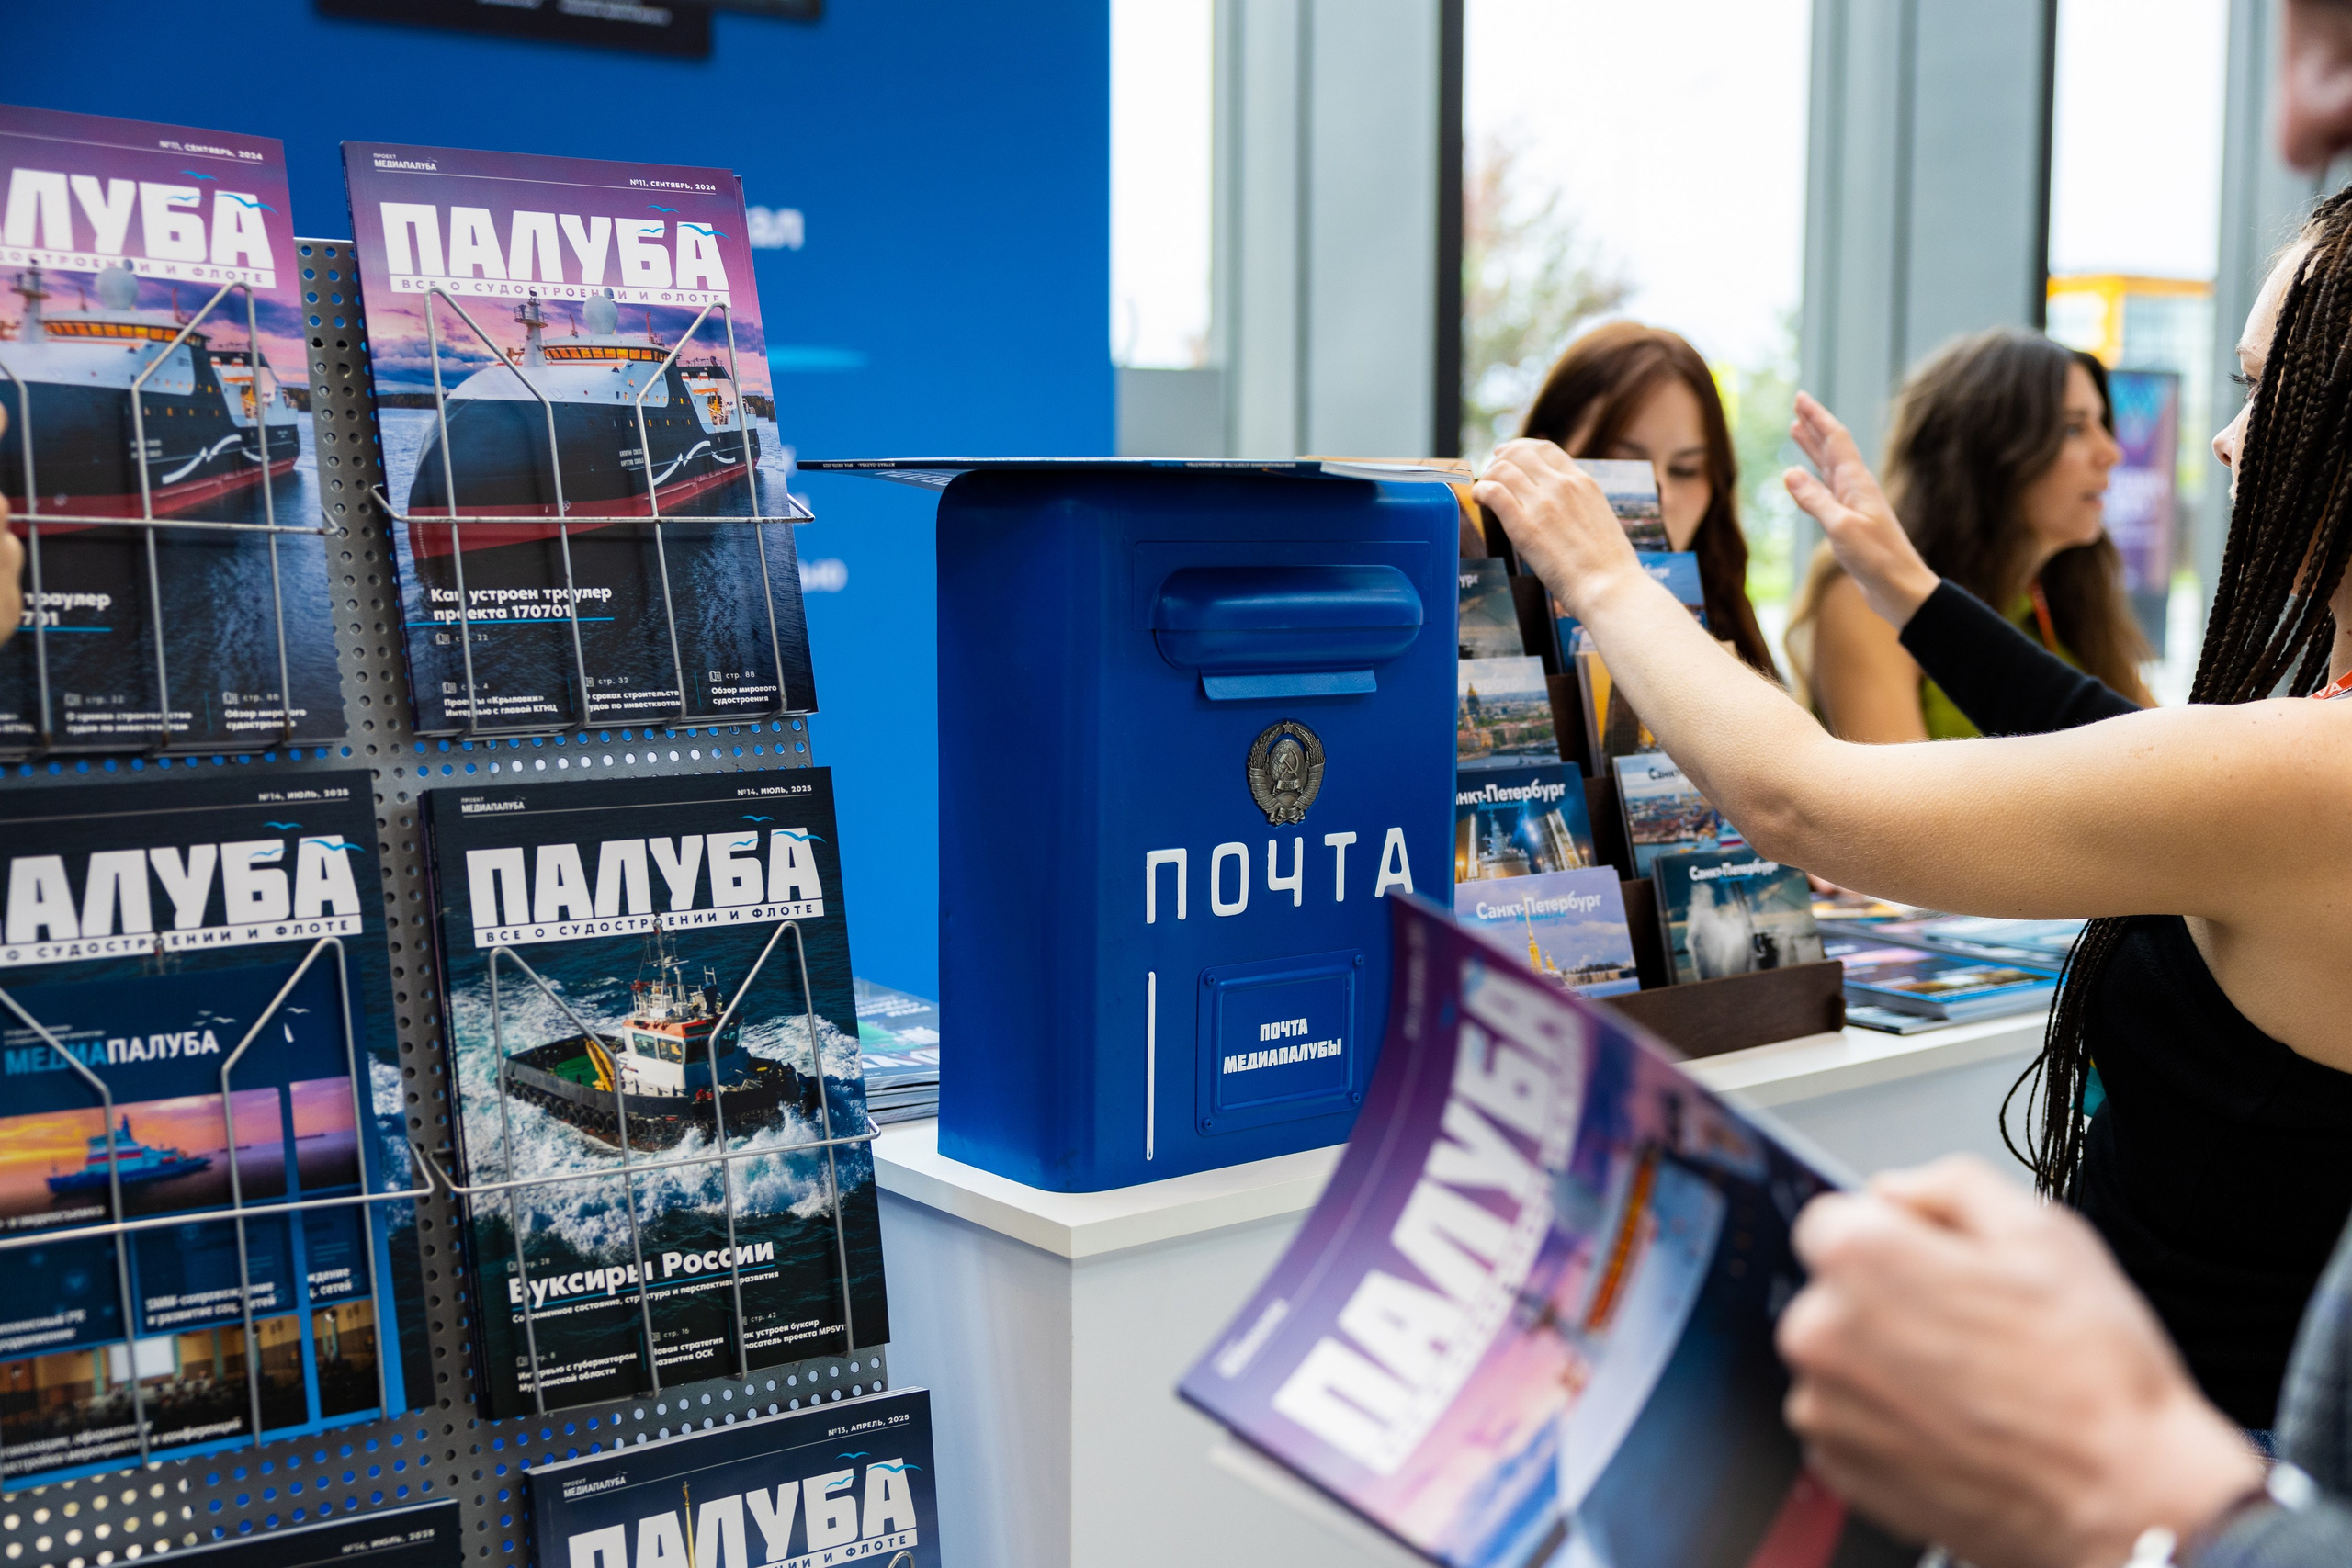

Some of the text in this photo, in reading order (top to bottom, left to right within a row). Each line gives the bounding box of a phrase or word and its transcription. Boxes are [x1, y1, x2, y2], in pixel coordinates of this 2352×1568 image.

[374, 160, 437, 171] МЕДИАПАЛУБА
[650, 181, 693, 190] СЕНТЯБРЬ,
[695, 183, 716, 191] 2024
[0, 168, 275, 270] ЛУБА
[379, 202, 729, 291] ПАЛУБА
[192, 267, 263, 283] ФЛОТЕ
[450, 281, 460, 291] О
[474, 283, 628, 299] СУДОСТРОЕНИ
[639, 291, 649, 301] И
[662, 292, 719, 304] ФЛОТЕ
[469, 589, 538, 605] устроен
[512, 604, 571, 619] 170701
[598, 676, 629, 686] стр. 32
[711, 685, 777, 695] Обзор мирового
[592, 693, 622, 702] сроках
[623, 690, 680, 700] строительств
[712, 695, 769, 705] судостроения
[445, 708, 492, 718] Интерью
[501, 705, 532, 715] главой
[533, 704, 558, 713] КГНЦ
[589, 704, 610, 713] удов
[761, 786, 788, 795] ИЮЛЬ,
[1456, 778, 1566, 805] нкт-Петербург
[461, 801, 526, 813] МЕДИАПАЛУБА
[466, 828, 822, 928] ПАЛУБА
[1146, 827, 1414, 924] ПОЧТА
[0, 835, 361, 945] АЛУБА
[1476, 890, 1601, 919] Санкт-Петербург
[247, 929, 258, 939] И
[276, 920, 347, 935] ФЛОТЕ
[486, 930, 521, 942] ВСЕ
[535, 928, 545, 938] О
[730, 910, 740, 920] И
[752, 904, 813, 918] ФЛОТЕ
[1260, 1018, 1308, 1042] ПОЧТА
[1223, 1038, 1342, 1075] МЕДИАПАЛУБЫ
[1272, 957, 1590, 1479] ПАЛУБА
[508, 1242, 775, 1309] Буксиры России
[513, 1306, 573, 1324] Соременное
[574, 1298, 624, 1312] состояние,
[625, 1290, 671, 1304] стрктура
[739, 1271, 779, 1286] развития
[756, 1325, 789, 1337] устроен
[790, 1319, 820, 1331] буксир
[680, 1337, 725, 1352] стратегия
[743, 1337, 783, 1349] пасатель
[783, 1331, 818, 1343] проекта
[654, 1348, 714, 1367] азвития ОСК
[517, 1366, 565, 1381] Интрвью
[578, 1367, 616, 1381] области
[828, 1414, 910, 1437] №13, АПРЕЛЬ, 2025
[563, 1476, 627, 1498] МЕДИАПАЛУБА
[567, 1457, 918, 1568] ПАЛУБА
[845, 1535, 908, 1558] ФЛОТЕ
